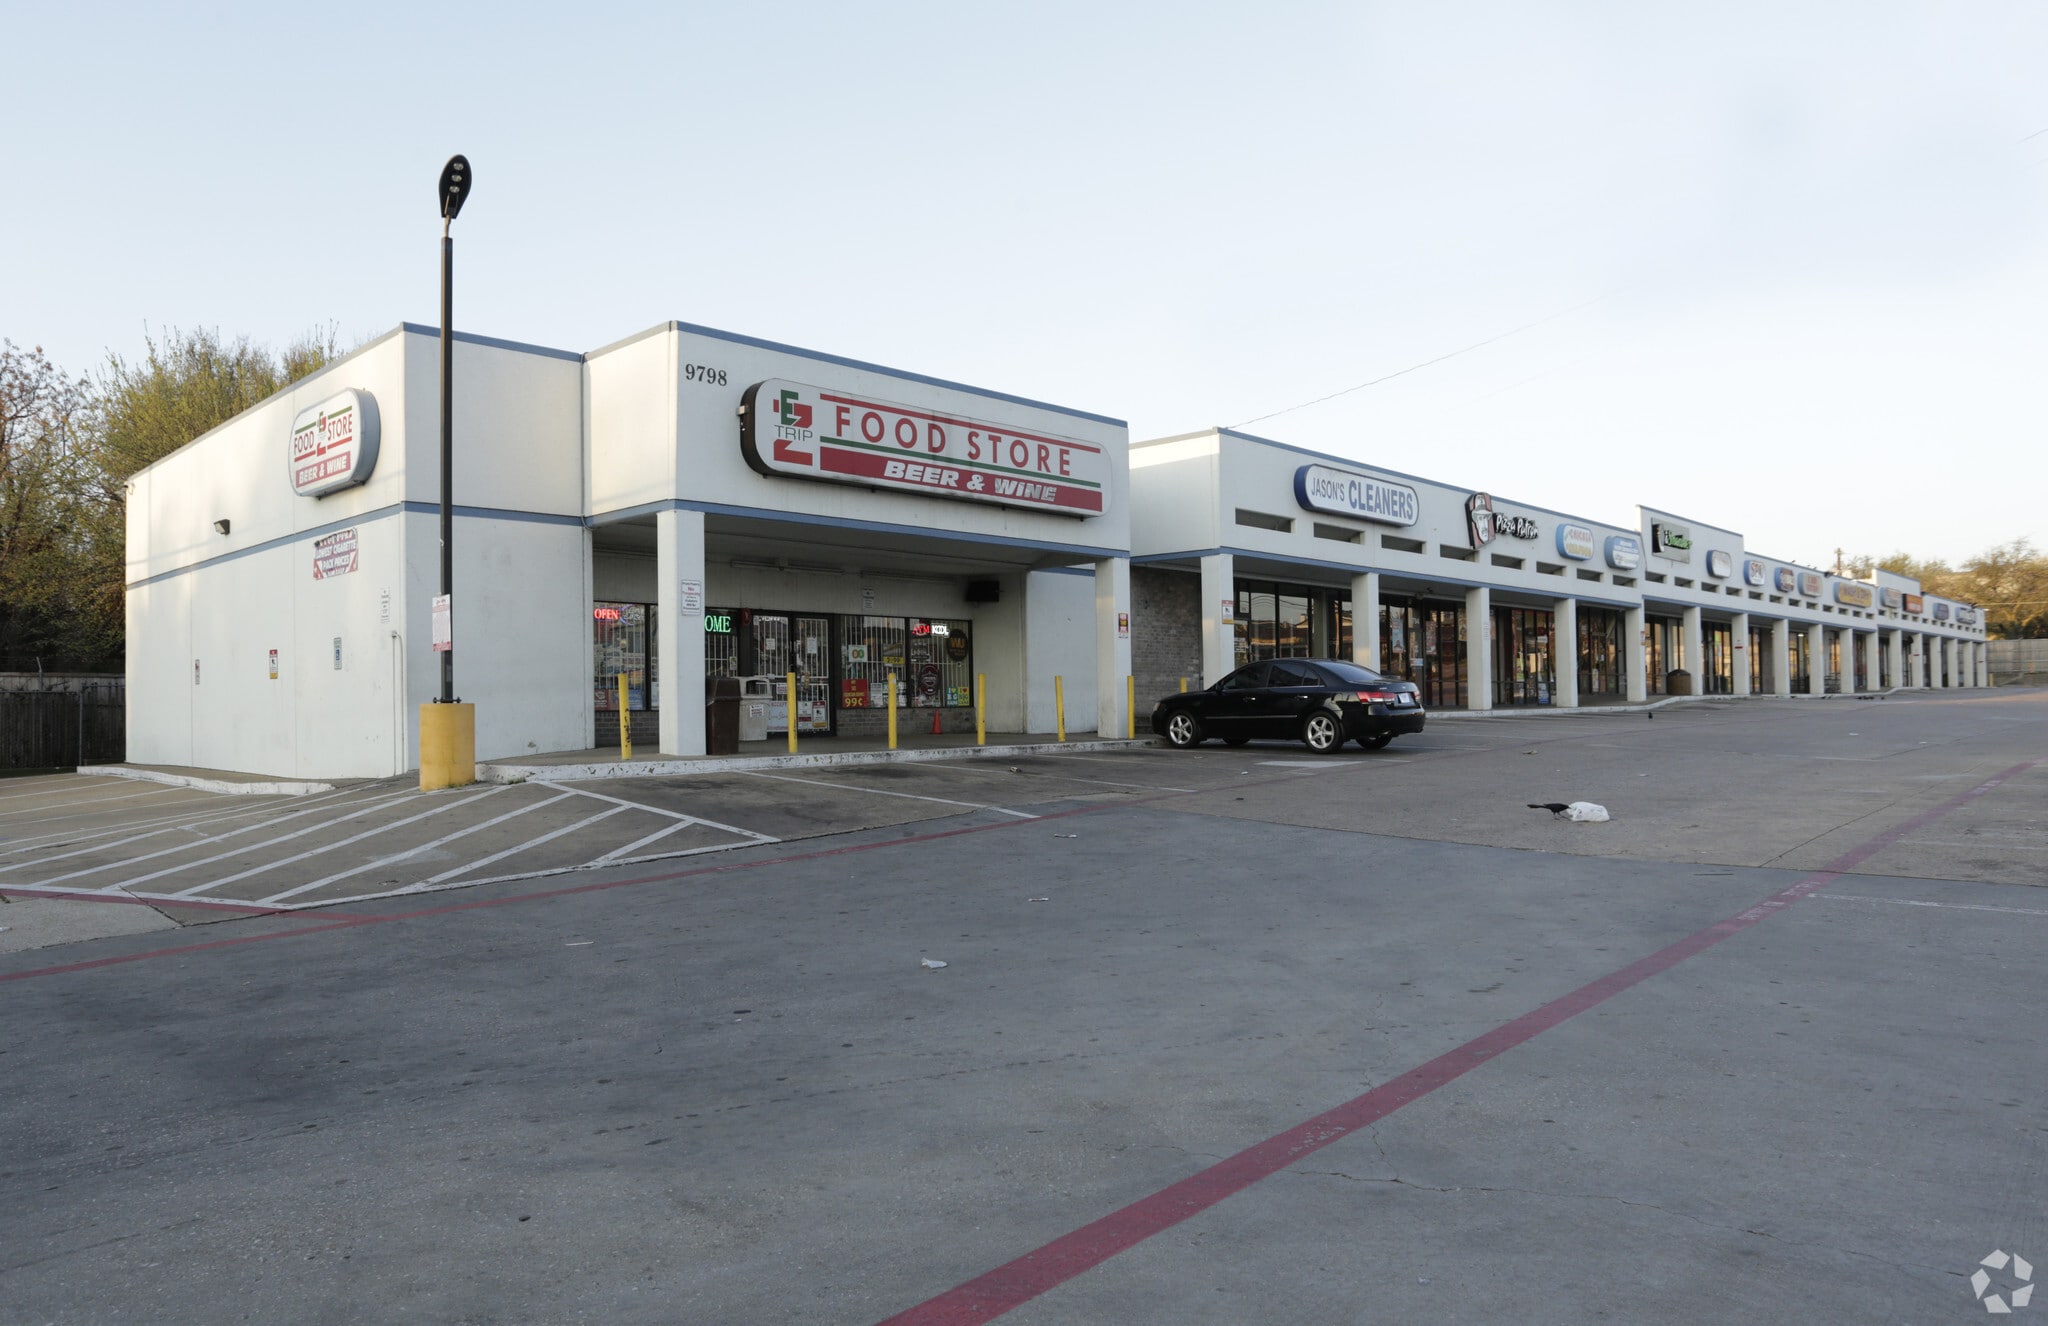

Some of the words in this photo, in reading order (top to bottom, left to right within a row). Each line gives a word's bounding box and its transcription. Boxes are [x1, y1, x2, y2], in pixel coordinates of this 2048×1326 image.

[685, 363, 728, 387] 9798
[294, 431, 314, 456] FOOD
[328, 413, 353, 441] STORE
[774, 424, 813, 441] TRIP
[836, 405, 946, 454] FOOD
[968, 430, 1071, 477] STORE
[298, 465, 318, 484] BEER
[319, 463, 325, 477] &
[326, 454, 348, 474] WINE
[883, 460, 960, 488] BEER
[967, 473, 985, 492] &
[993, 477, 1058, 502] WINE
[1310, 476, 1346, 502] JASON'S
[1348, 479, 1414, 521] CLEANERS
[1496, 513, 1516, 533] Pizza
[334, 554, 350, 568] PRICES
[594, 608, 619, 620] OPEN
[932, 624, 949, 636] KOOL
[845, 697, 863, 707] 99¢
